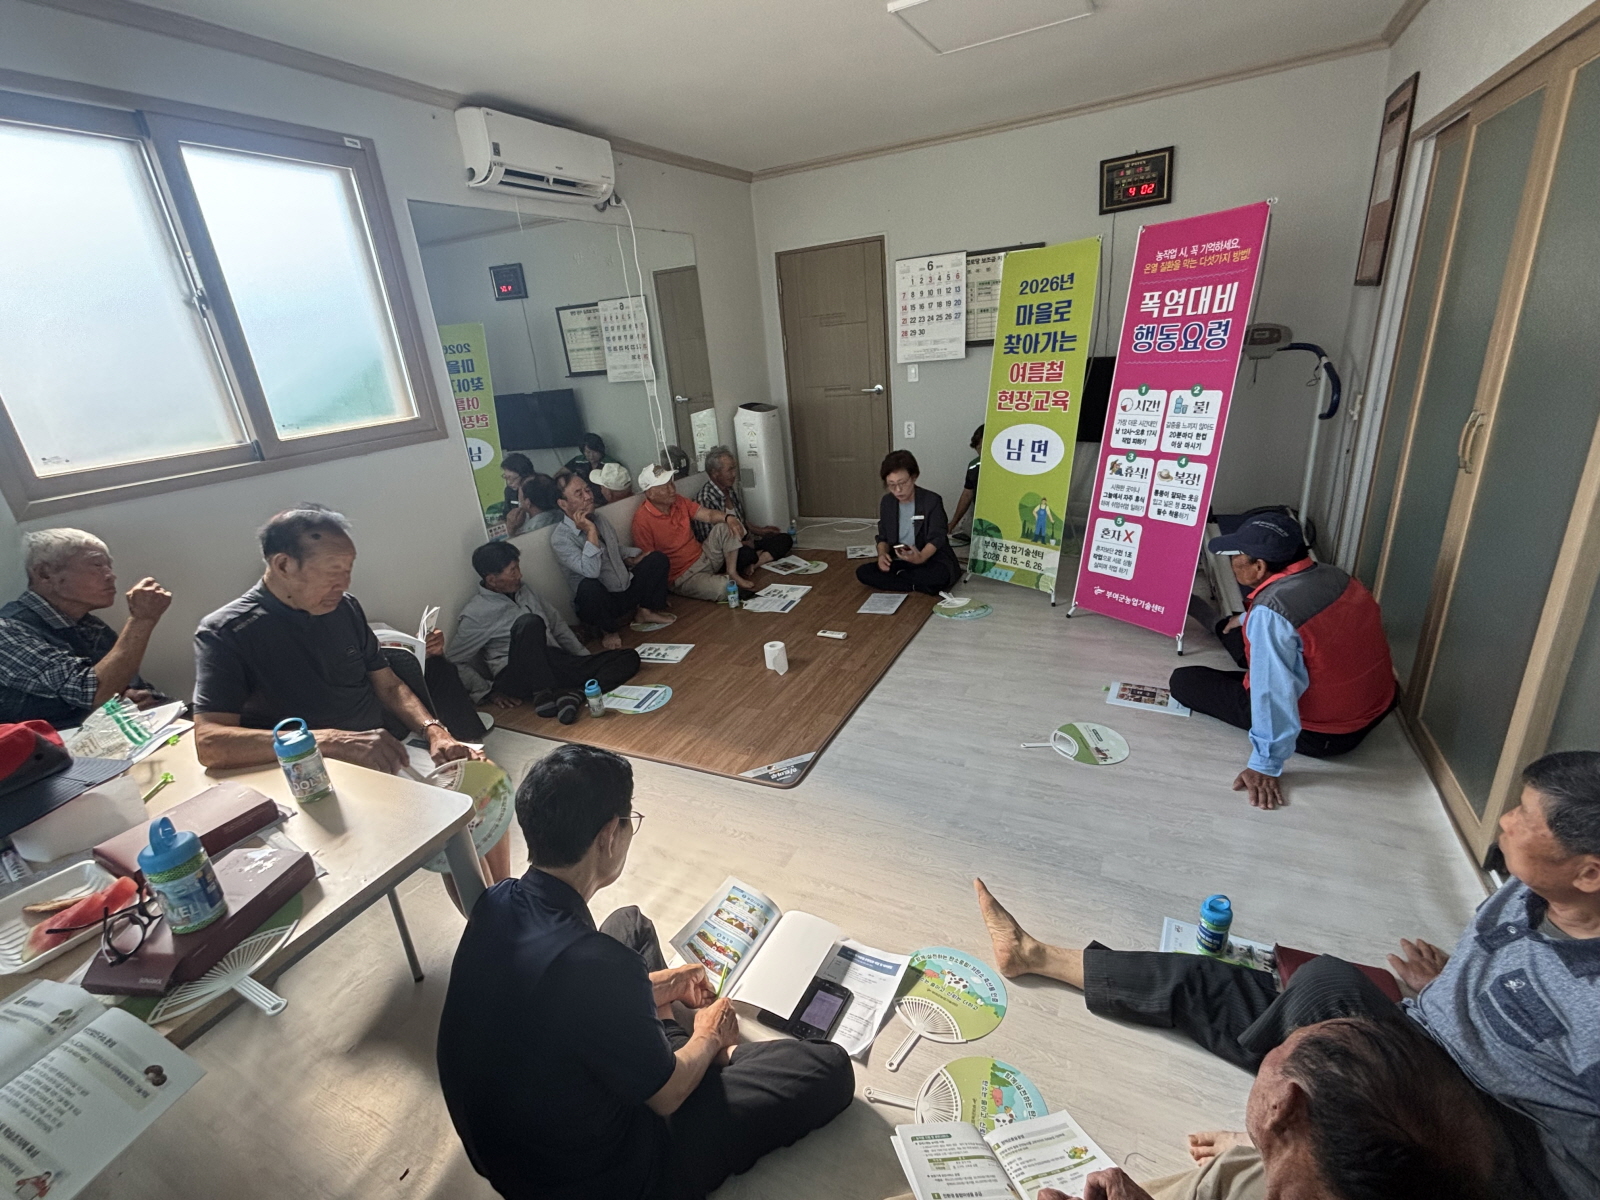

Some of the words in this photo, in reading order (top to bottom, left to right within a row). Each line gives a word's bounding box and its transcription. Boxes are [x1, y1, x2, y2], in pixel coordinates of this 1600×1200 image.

[1143, 263, 1158, 274] 온열
[1160, 259, 1181, 273] 질환을
[1182, 257, 1198, 269] 막는
[1200, 252, 1231, 266] 다섯가지
[1232, 248, 1252, 263] 방법!
[1156, 248, 1178, 262] 농작업
[1190, 245, 1199, 256] 꼭
[926, 260, 935, 271] 6
[910, 278, 915, 286] 1
[918, 277, 924, 285] 2
[927, 275, 933, 284] 3
[936, 274, 942, 282] 4
[945, 273, 951, 281] 5
[954, 272, 960, 280] 6
[1019, 272, 1075, 296] 2026년
[901, 291, 907, 300] 7
[910, 291, 916, 299] 8
[919, 290, 925, 298] 9
[927, 289, 934, 297] 10
[936, 288, 942, 296] 11
[945, 286, 952, 294] 12
[954, 285, 961, 293] 13
[1139, 281, 1239, 319] 폭염대비
[953, 299, 962, 307] 20
[953, 312, 962, 320] 27
[1015, 299, 1073, 327] 마을로
[901, 330, 909, 338] 28
[909, 329, 917, 337] 29
[918, 328, 926, 336] 30
[1132, 318, 1233, 353] 행동요령
[1003, 330, 1078, 355] 찾아가는
[1009, 360, 1065, 384] 여름철
[996, 389, 1071, 413] 현장교육
[1134, 400, 1161, 413] 시간!
[1192, 401, 1210, 414] 물!
[1121, 437, 1132, 445] 작업
[1171, 440, 1183, 449] 이상
[1184, 441, 1202, 451] 마시기
[1124, 466, 1149, 480] 휴식!
[1174, 471, 1201, 487] 복장!
[1102, 491, 1123, 501] 그늘에서
[1123, 494, 1134, 502] 자주
[1100, 527, 1122, 542] 혼자
[983, 540, 1045, 560] 부여군농업기술센터
[1105, 590, 1165, 615] 부여군농업기술센터
